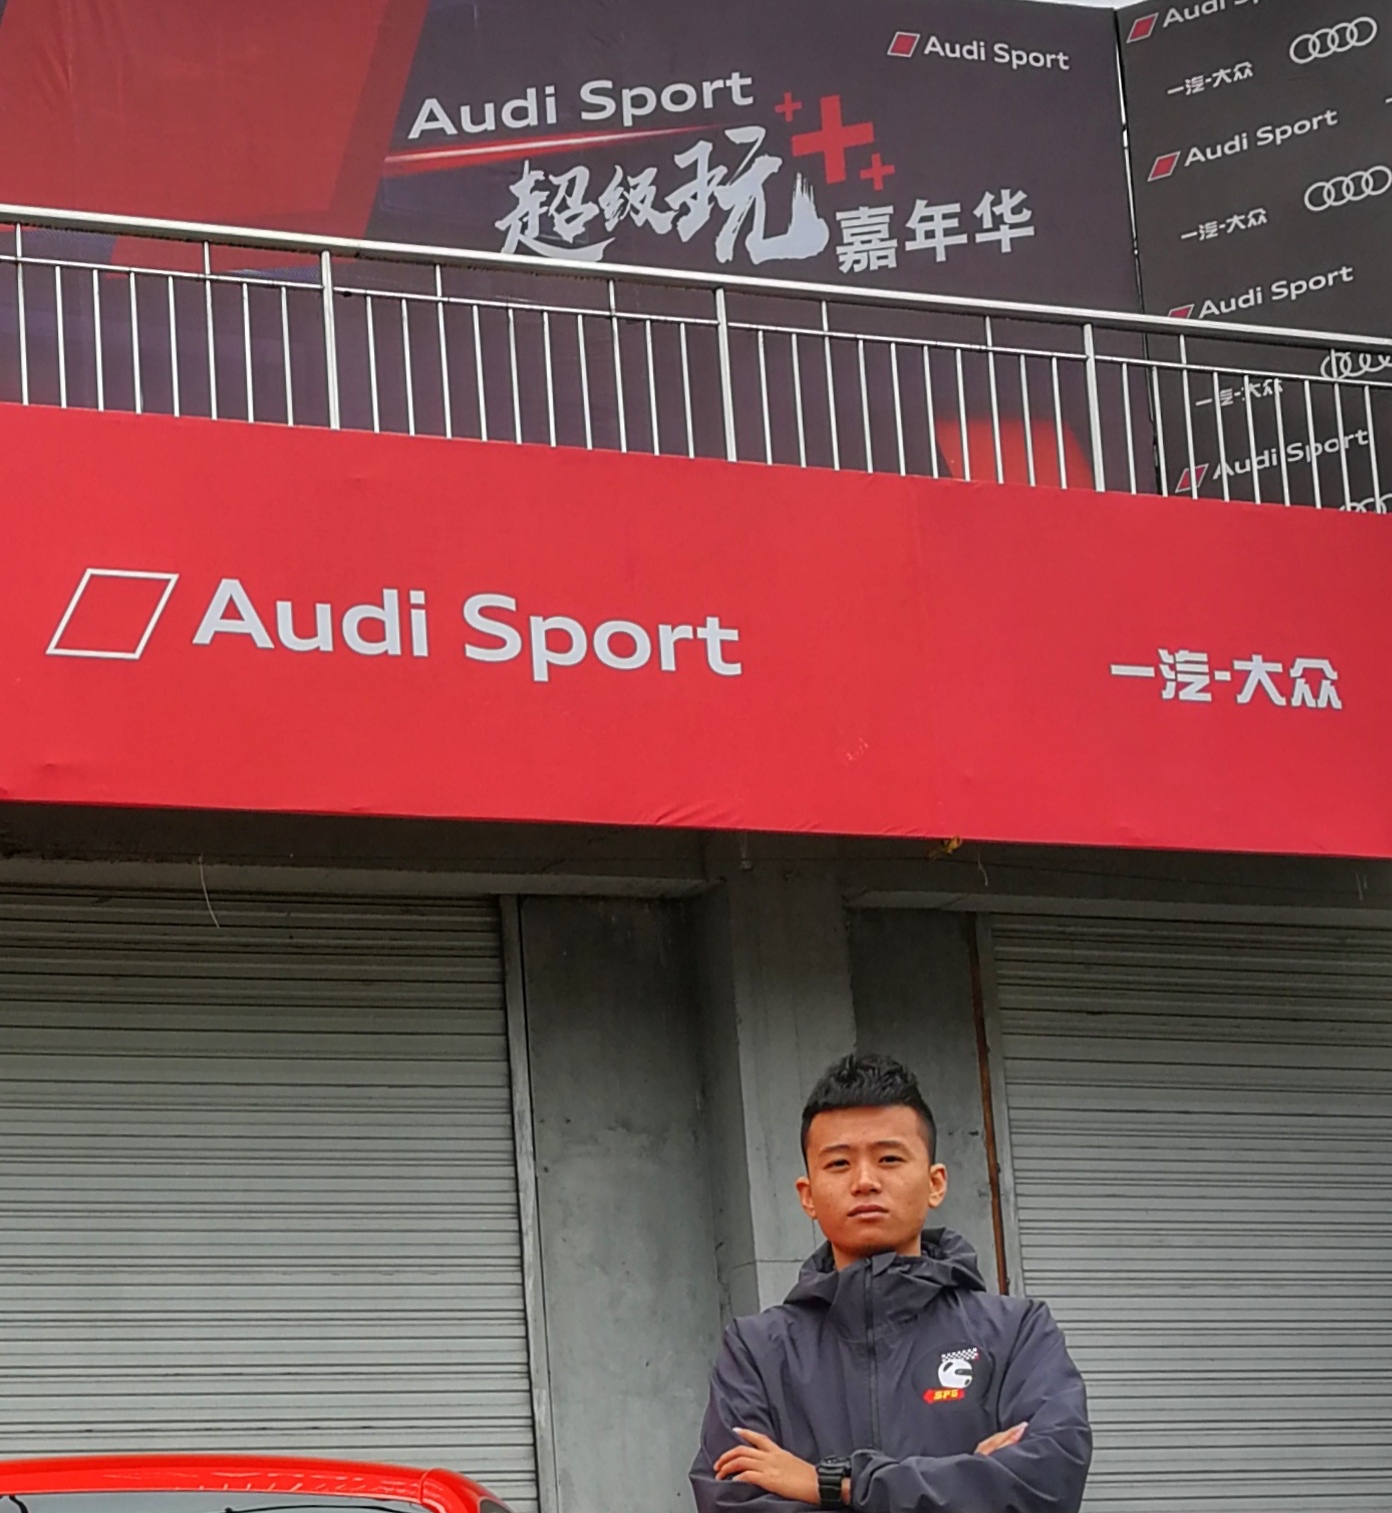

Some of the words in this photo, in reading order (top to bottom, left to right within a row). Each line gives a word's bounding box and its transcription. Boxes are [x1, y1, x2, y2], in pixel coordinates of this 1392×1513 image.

[923, 36, 986, 62] Audi
[992, 42, 1070, 70] Sport
[1167, 61, 1254, 95] 一汽-大众
[407, 85, 558, 139] Audi
[578, 71, 754, 127] Sport
[1184, 133, 1249, 167] Audi
[1256, 109, 1339, 145] Sport
[494, 126, 829, 264] 超级玩
[835, 189, 1036, 274] 嘉年华
[1180, 207, 1268, 241] 一汽-大众
[1198, 286, 1263, 319] Audi
[1270, 266, 1354, 300] Sport
[192, 578, 429, 657] Audi
[462, 594, 743, 683] Sport
[1110, 648, 1343, 709] 一汽-大众
